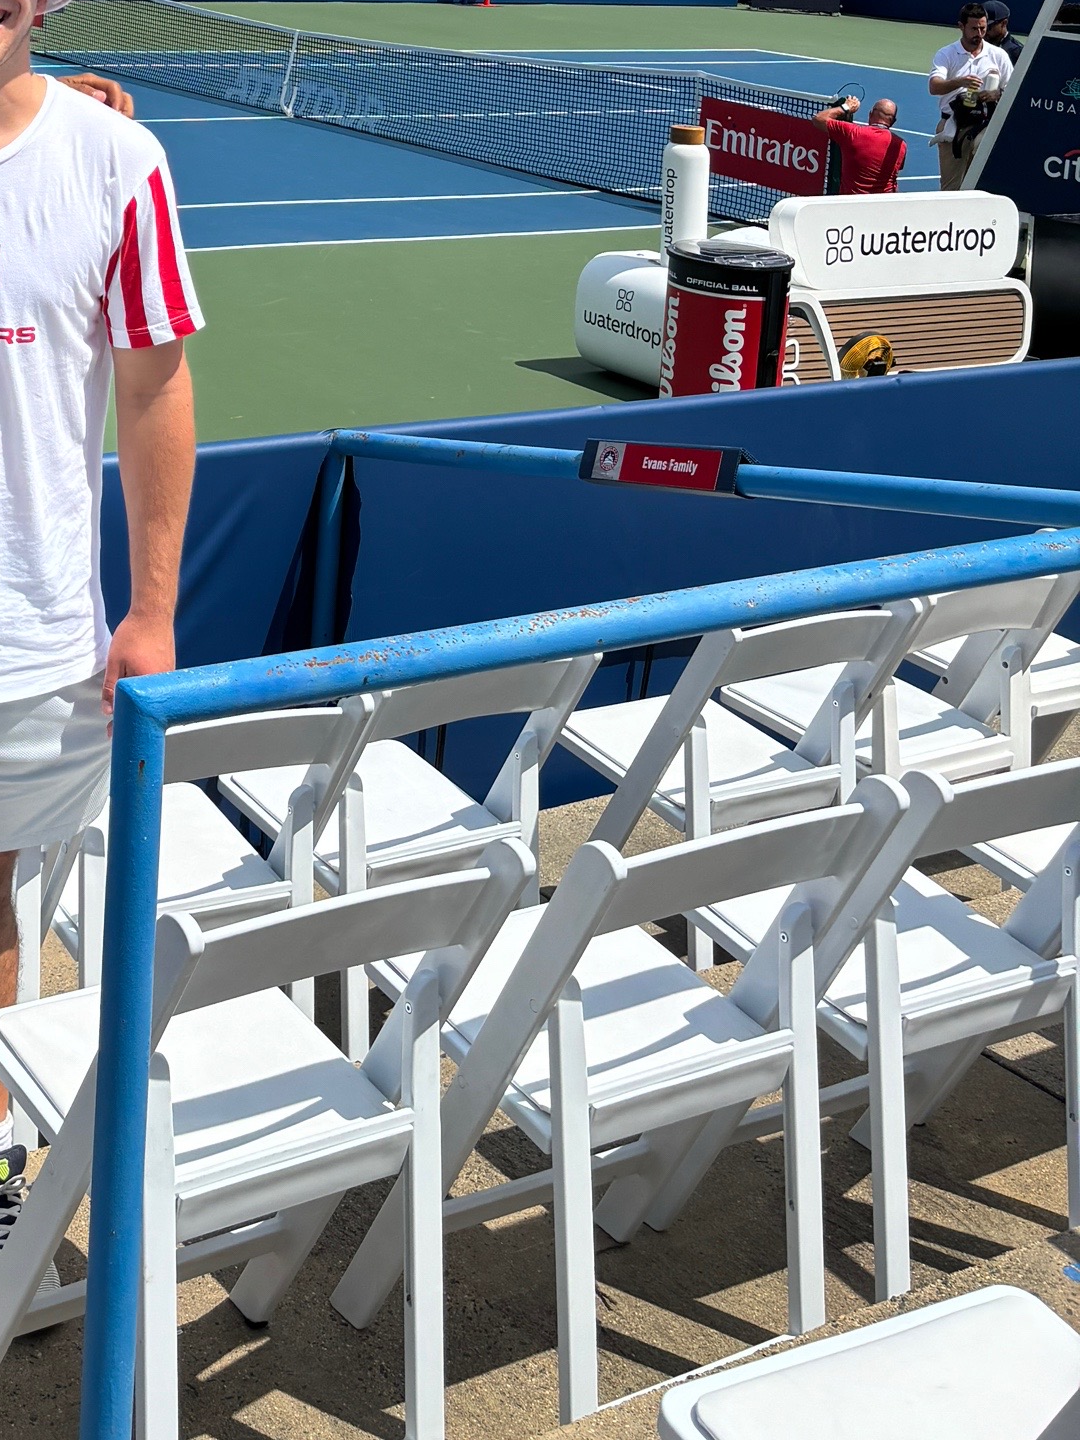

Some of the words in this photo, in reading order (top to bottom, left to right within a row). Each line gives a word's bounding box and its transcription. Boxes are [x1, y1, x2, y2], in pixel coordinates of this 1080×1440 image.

[705, 117, 819, 174] Emirates
[664, 168, 678, 249] waterdrop
[859, 221, 996, 258] waterdrop
[686, 276, 730, 291] OFFICIAL
[731, 284, 759, 293] BALL
[583, 309, 662, 350] waterdrop
[709, 307, 748, 394] ilson
[642, 456, 667, 471] Evans
[669, 459, 698, 476] Family
